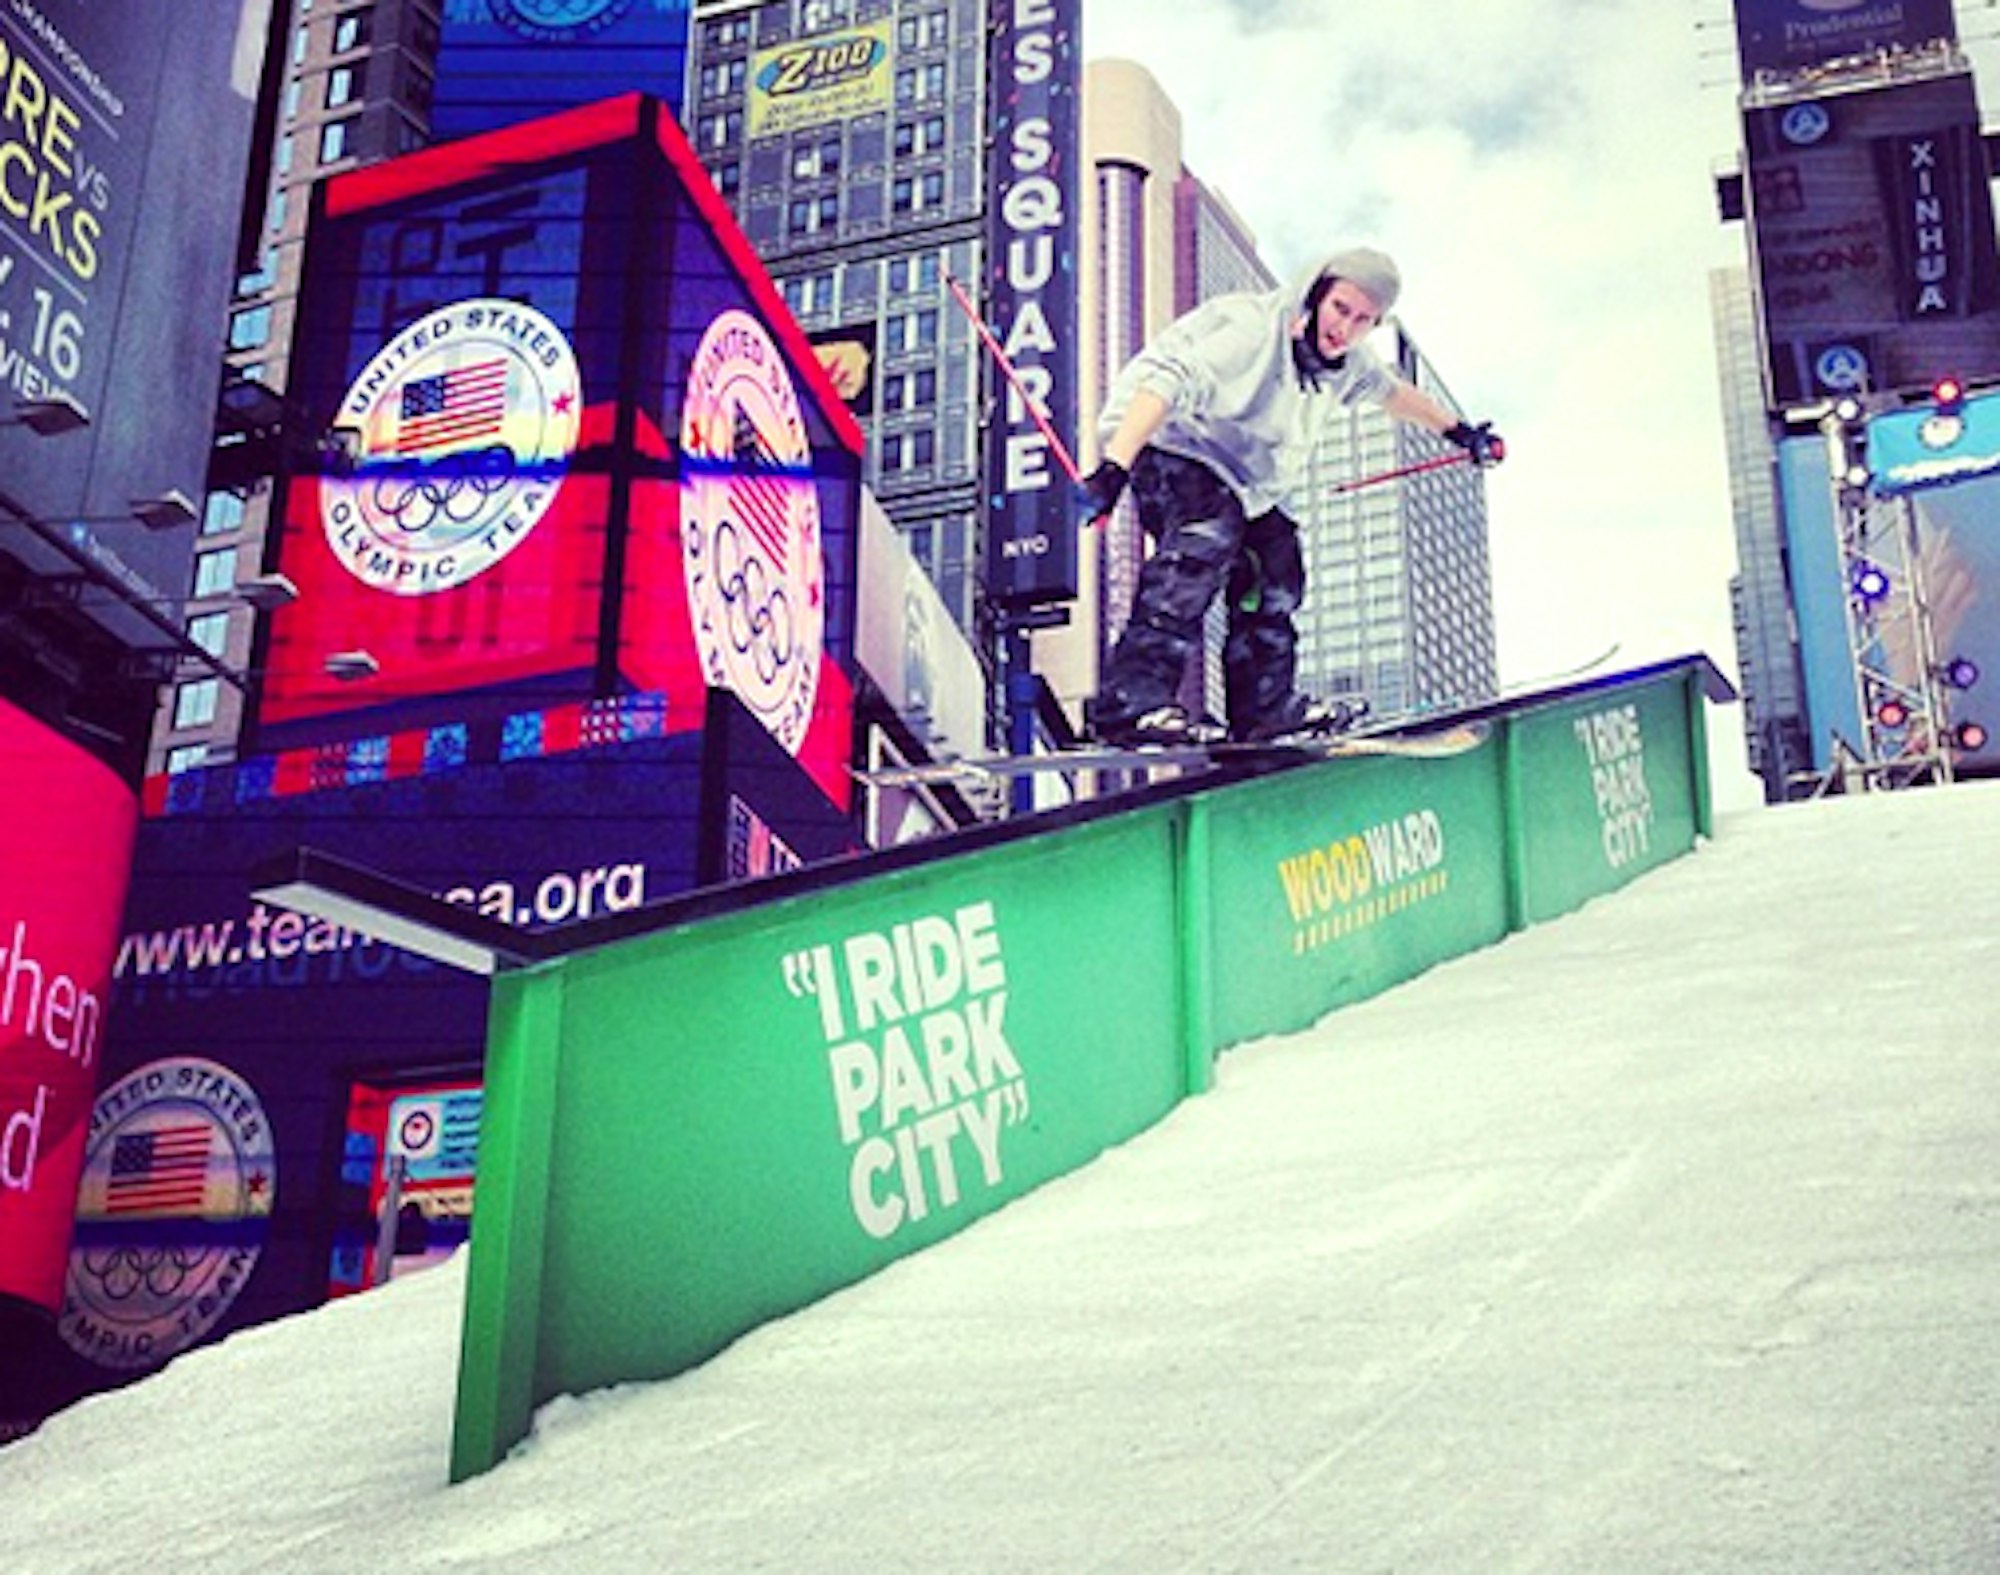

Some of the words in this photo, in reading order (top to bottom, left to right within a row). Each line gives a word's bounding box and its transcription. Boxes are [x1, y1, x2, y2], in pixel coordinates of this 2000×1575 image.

[767, 37, 875, 97] Z100
[0, 36, 82, 178] RE
[74, 149, 109, 212] VS
[1910, 138, 1948, 314] XINHUA
[33, 287, 84, 380] 16
[1001, 117, 1063, 492] SQUARE
[350, 317, 453, 415] UNITED
[462, 306, 562, 369] STATES
[330, 501, 456, 581] OLYMPIC
[1592, 703, 1643, 764] RIDE
[1592, 752, 1652, 819] PARK
[1278, 809, 1443, 922] WOODWARD
[0, 919, 99, 1068] hen
[844, 900, 1007, 1032] RIDE
[177, 1067, 260, 1141] STATES
[828, 990, 1024, 1145] PARK
[0, 1083, 47, 1193] d
